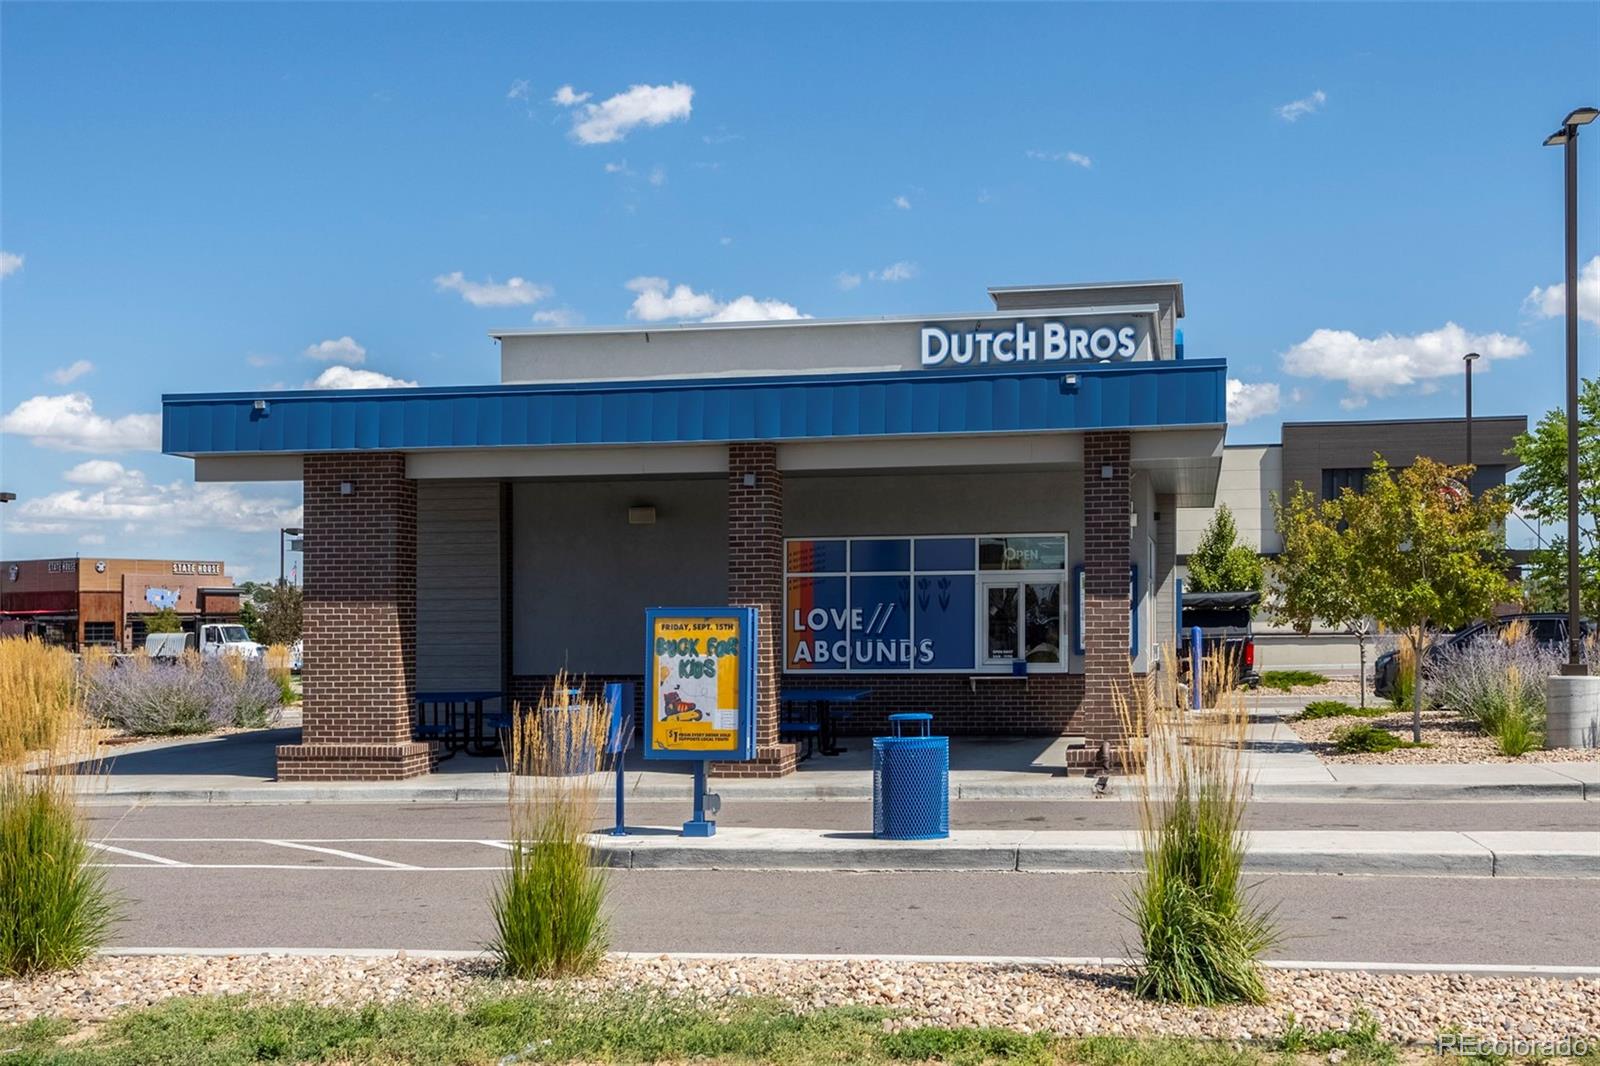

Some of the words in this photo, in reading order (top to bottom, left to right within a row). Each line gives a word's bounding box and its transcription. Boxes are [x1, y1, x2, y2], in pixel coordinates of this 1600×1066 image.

[1003, 547, 1039, 561] OPEN
[172, 563, 195, 575] STATE
[198, 563, 221, 575] HOUSE
[661, 623, 691, 632] FRIDAY,
[693, 623, 713, 631] SEPT.
[715, 623, 734, 631] 15TH
[656, 637, 700, 657] BUCK
[707, 637, 739, 657] FOR
[792, 638, 936, 664] ABOUNDS
[679, 658, 716, 679] KIDS
